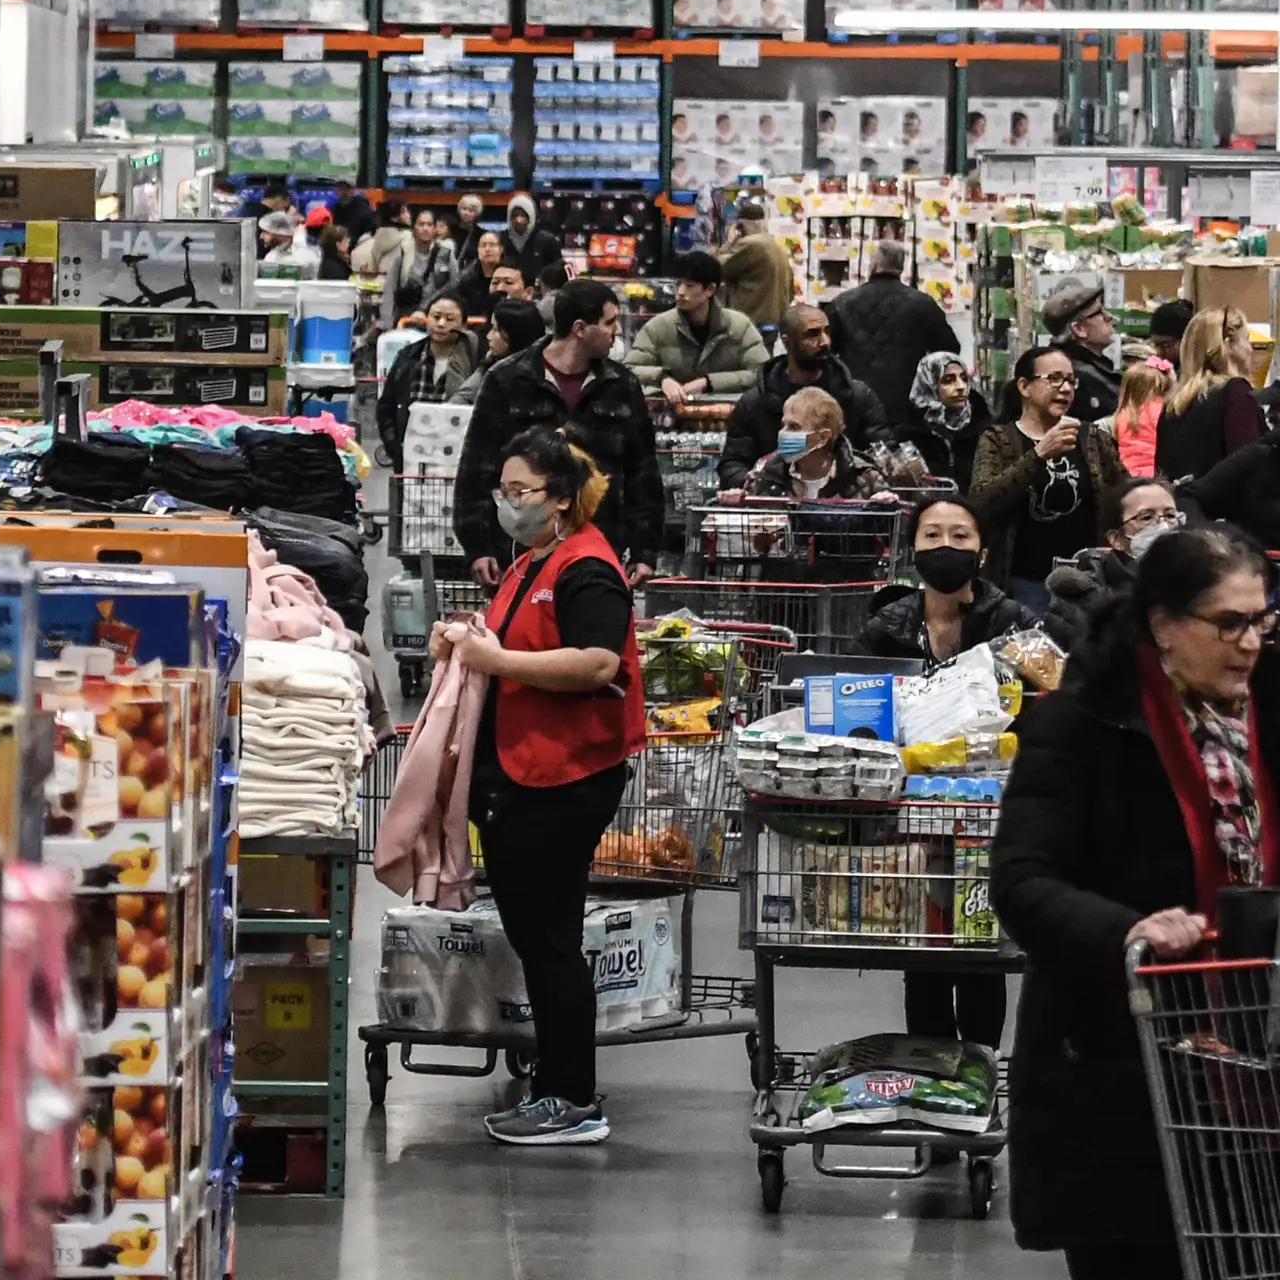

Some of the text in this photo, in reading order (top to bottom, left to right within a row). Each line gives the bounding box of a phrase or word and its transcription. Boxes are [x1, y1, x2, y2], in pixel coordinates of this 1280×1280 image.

[1074, 186, 1102, 198] 7.99
[102, 229, 216, 261] HAZE
[840, 678, 886, 696] OREO
[436, 935, 484, 955] Towel
[587, 941, 643, 983] Towel
[271, 994, 304, 1005] PACK
